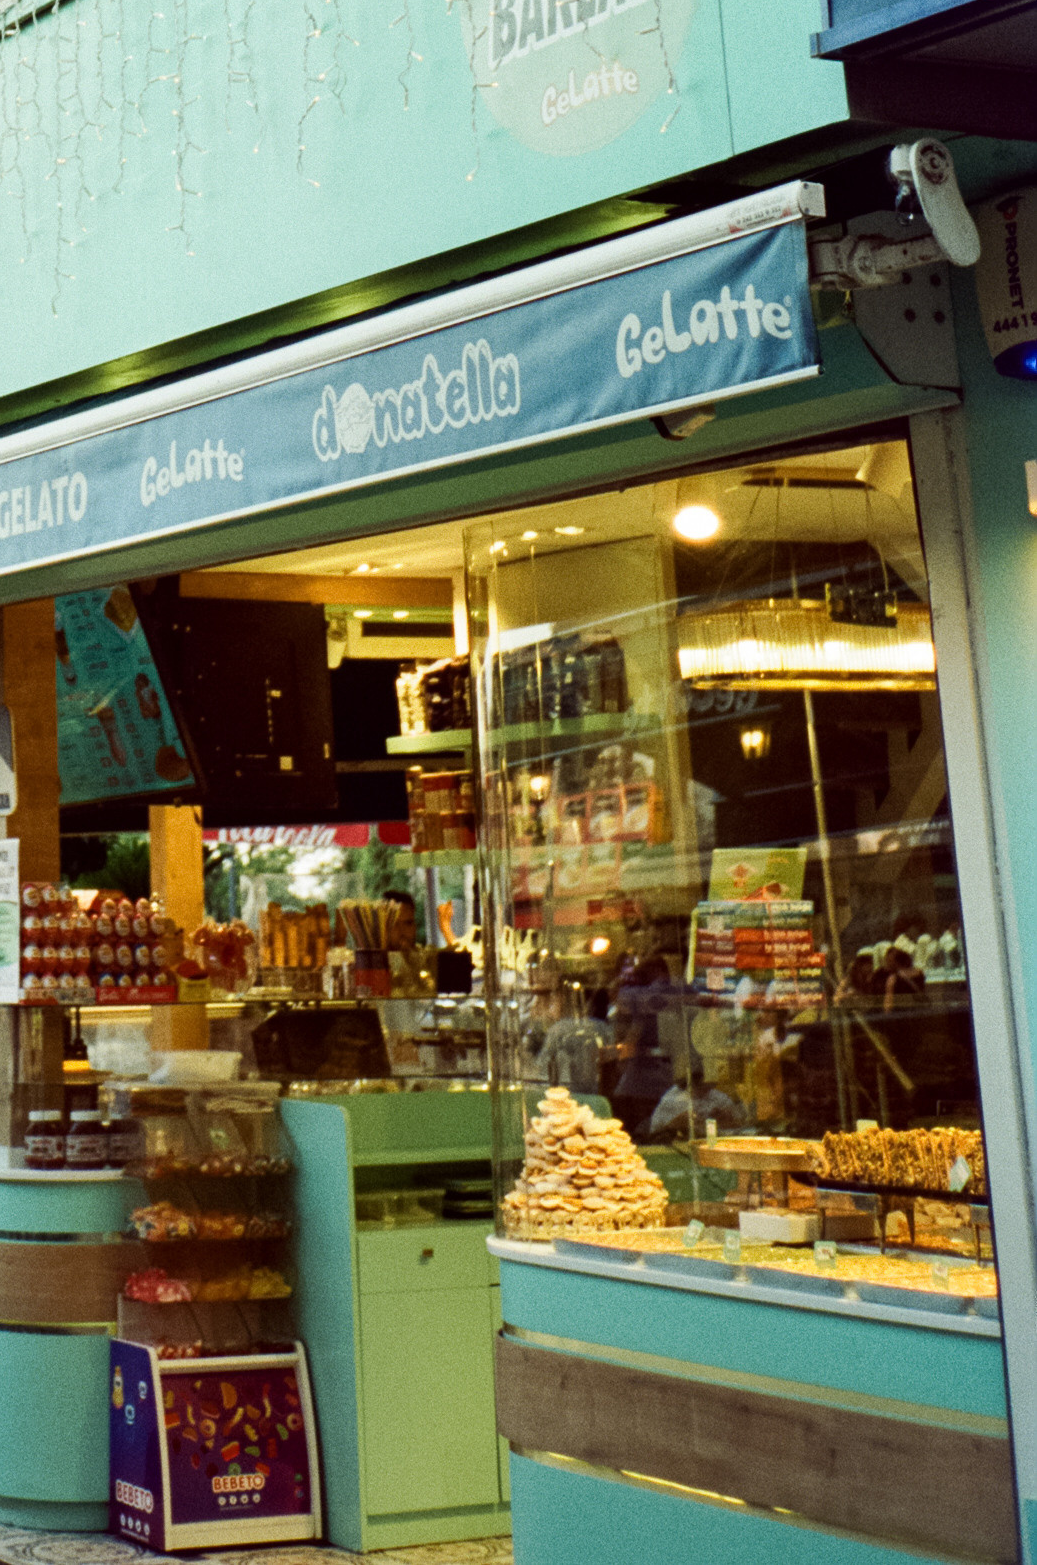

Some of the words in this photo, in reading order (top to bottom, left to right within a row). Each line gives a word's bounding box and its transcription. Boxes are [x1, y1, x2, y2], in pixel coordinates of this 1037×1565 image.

[1005, 221, 1025, 310] PRONET
[312, 338, 521, 463] donatella
[116, 1479, 154, 1514] BEBETO
[212, 1474, 265, 1494] BEBETO
